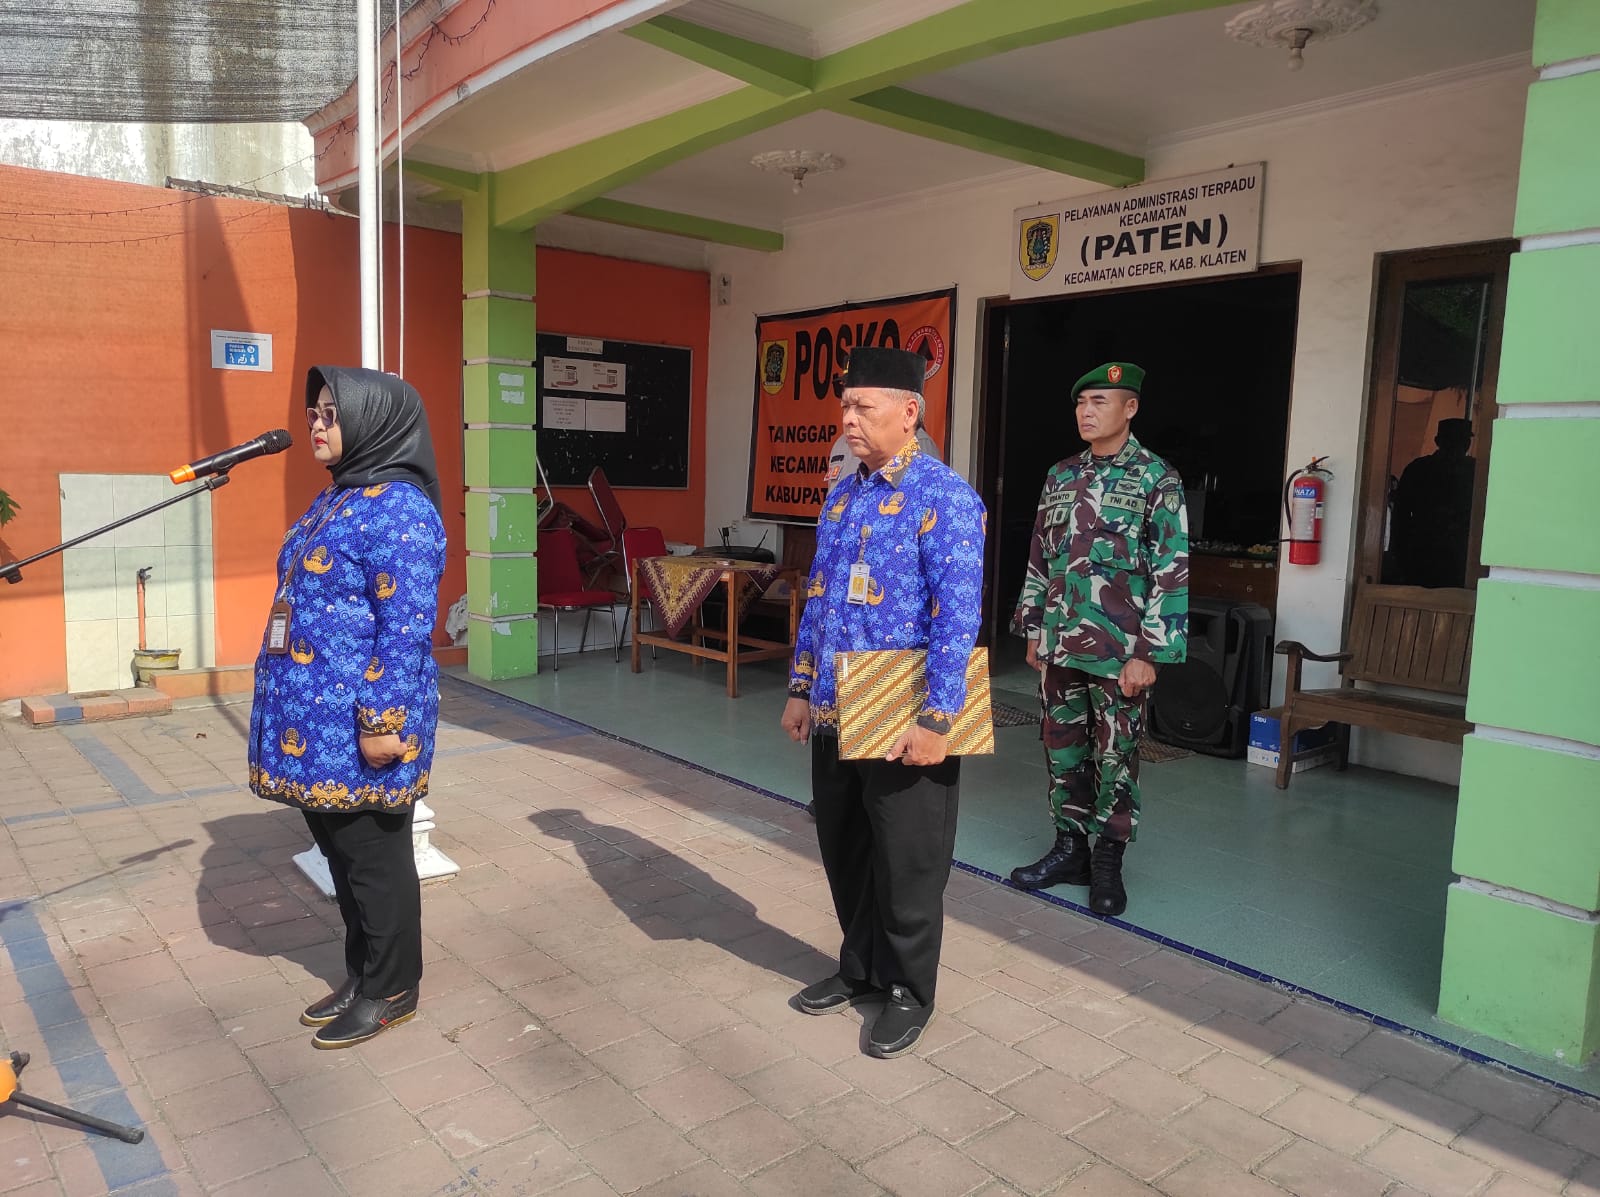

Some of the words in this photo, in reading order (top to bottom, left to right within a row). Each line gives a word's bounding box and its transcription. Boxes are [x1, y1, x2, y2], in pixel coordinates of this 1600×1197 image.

[1064, 201, 1121, 223] PELAYANAN
[1123, 187, 1198, 212] ADMINISTRASI
[1201, 176, 1256, 199] TERPADU
[1119, 205, 1187, 227] KECAMATAN
[1064, 265, 1125, 285] KECAMATAN
[1128, 261, 1167, 283] CEPER,
[1170, 256, 1196, 273] KAB.
[1200, 249, 1247, 268] KLATEN
[768, 425, 837, 443] TANGGAP
[770, 456, 830, 473] KECAMA
[1110, 496, 1122, 505] TNI
[1126, 499, 1138, 508] AD
